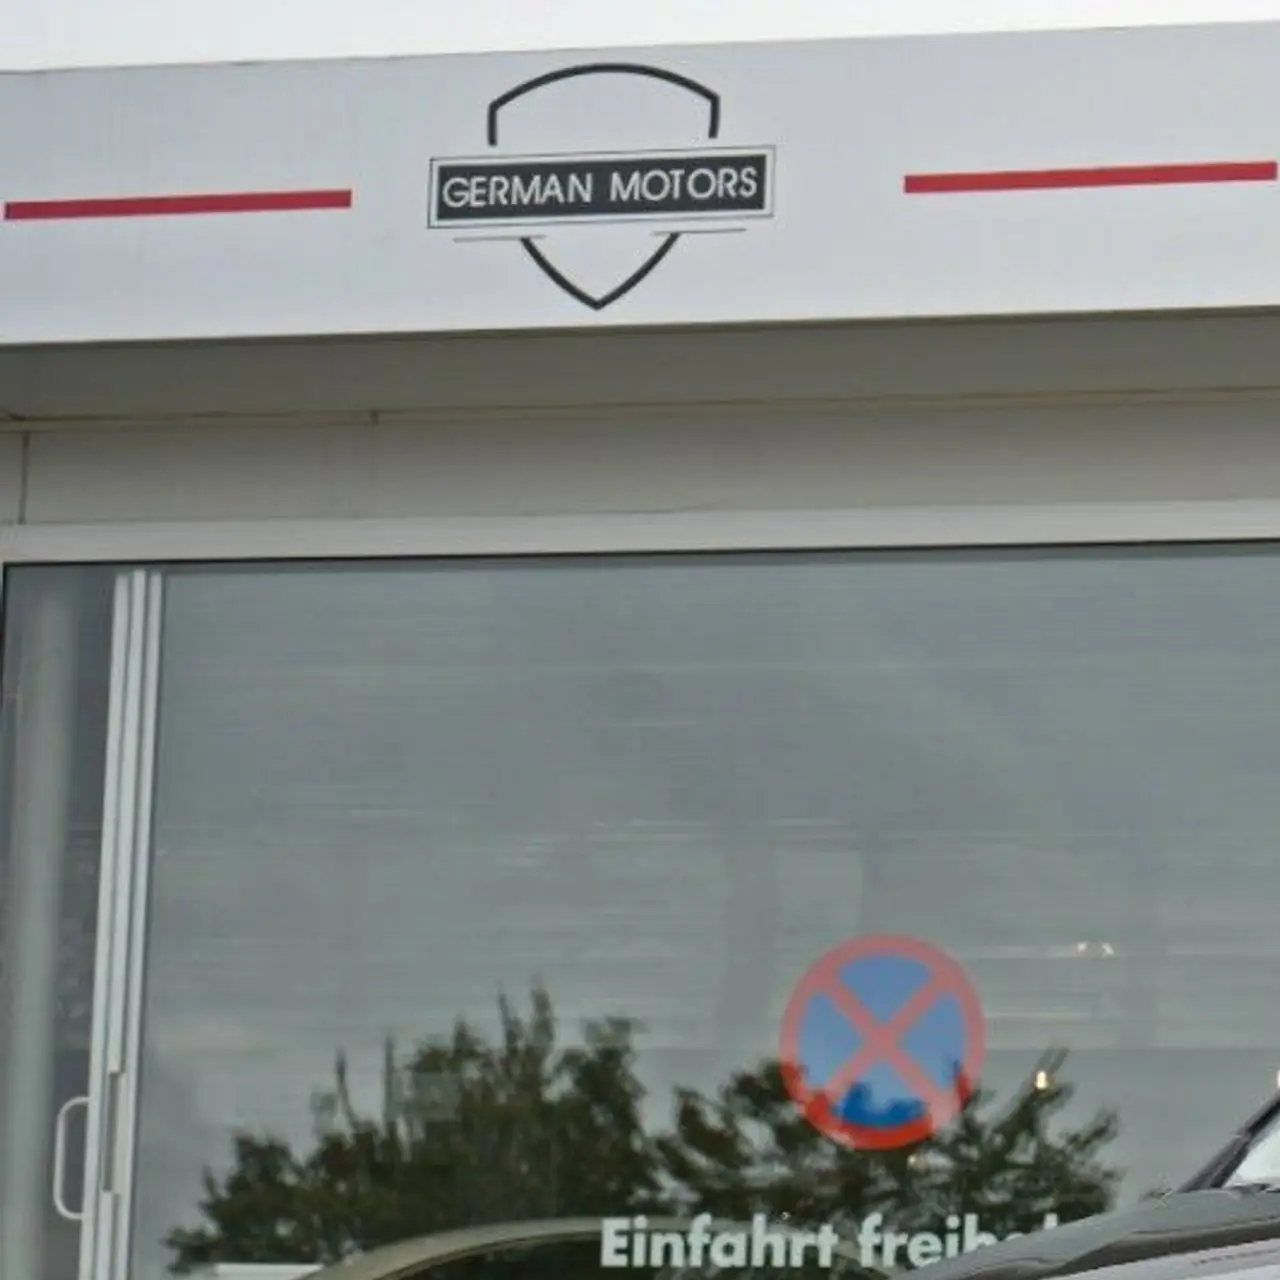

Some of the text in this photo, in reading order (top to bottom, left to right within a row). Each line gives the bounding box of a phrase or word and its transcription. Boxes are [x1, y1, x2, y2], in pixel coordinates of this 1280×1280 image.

[442, 166, 758, 208] GERMAN MOTORS
[600, 1214, 838, 1268] Einfahrt
